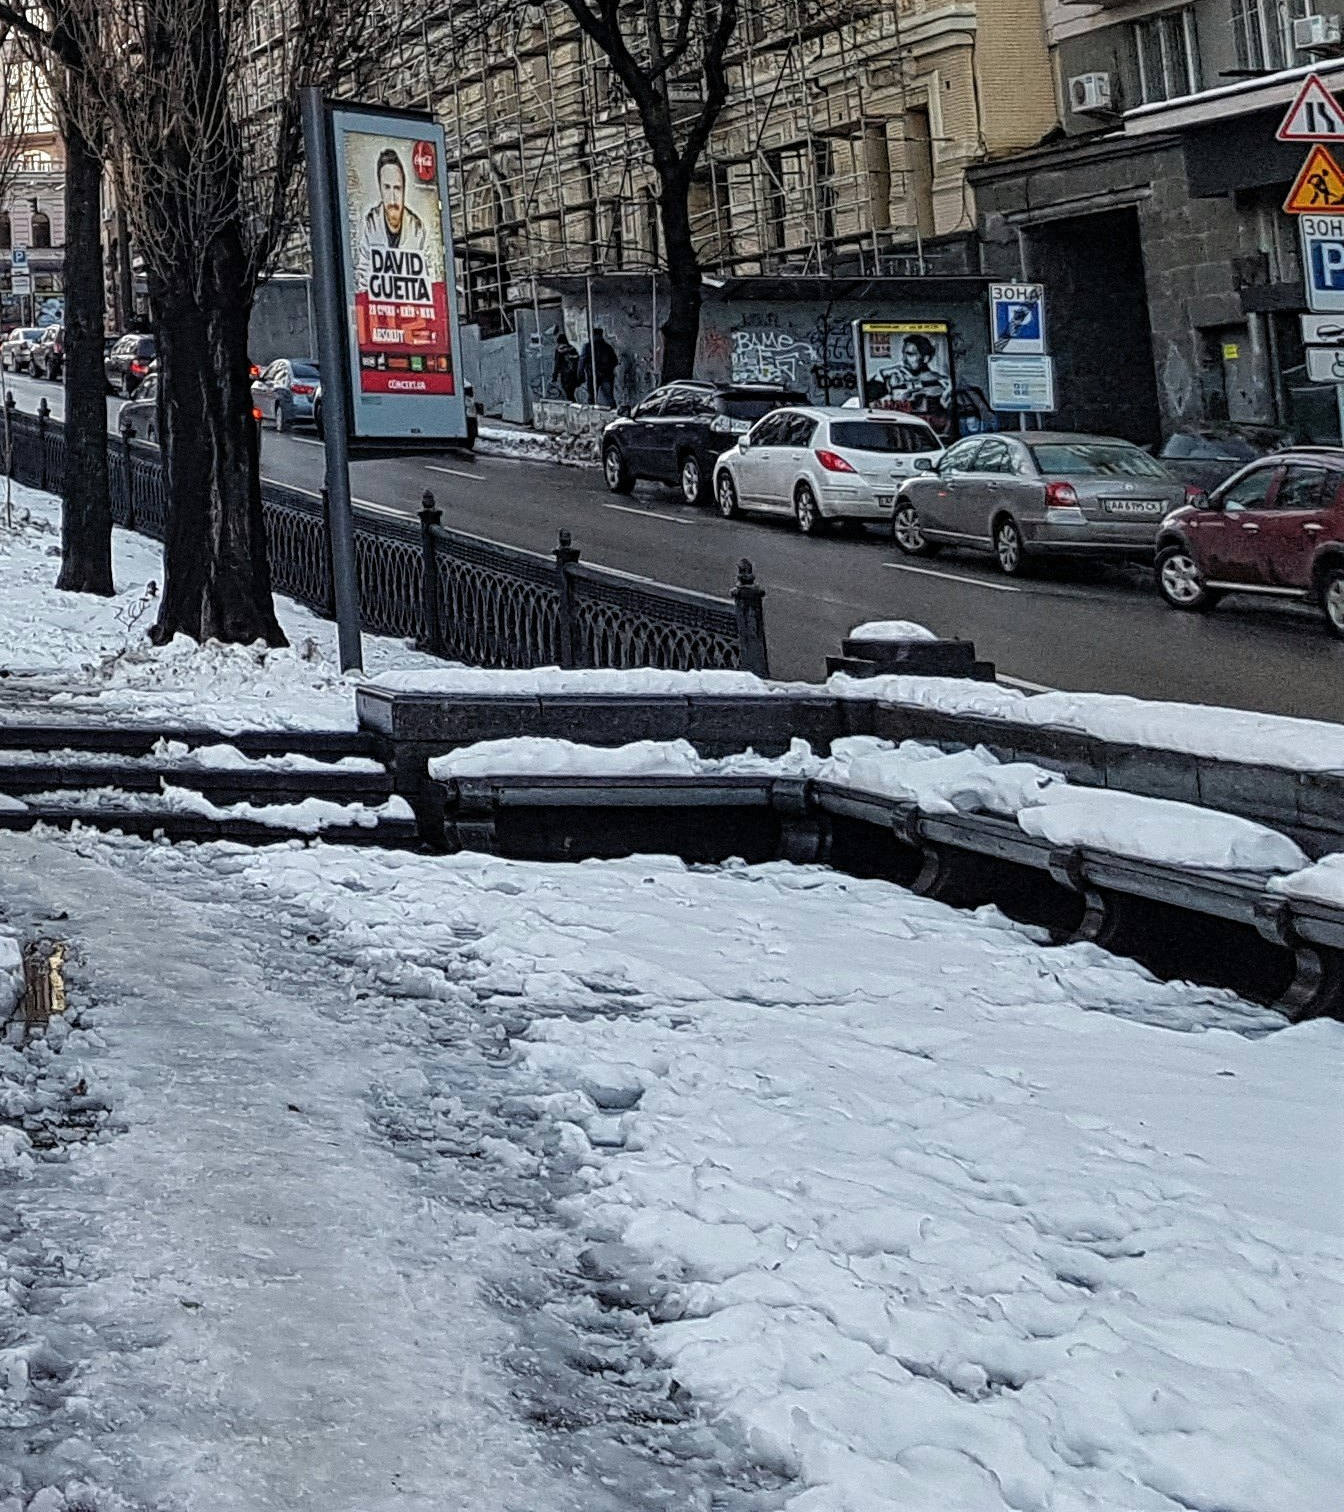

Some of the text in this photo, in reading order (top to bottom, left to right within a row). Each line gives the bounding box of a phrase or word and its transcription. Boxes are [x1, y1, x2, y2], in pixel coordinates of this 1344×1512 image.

[1305, 218, 1344, 236] ЗОН
[371, 249, 424, 276] DAVID
[369, 274, 431, 302] GUETTA
[992, 287, 1041, 301] ЗОНА
